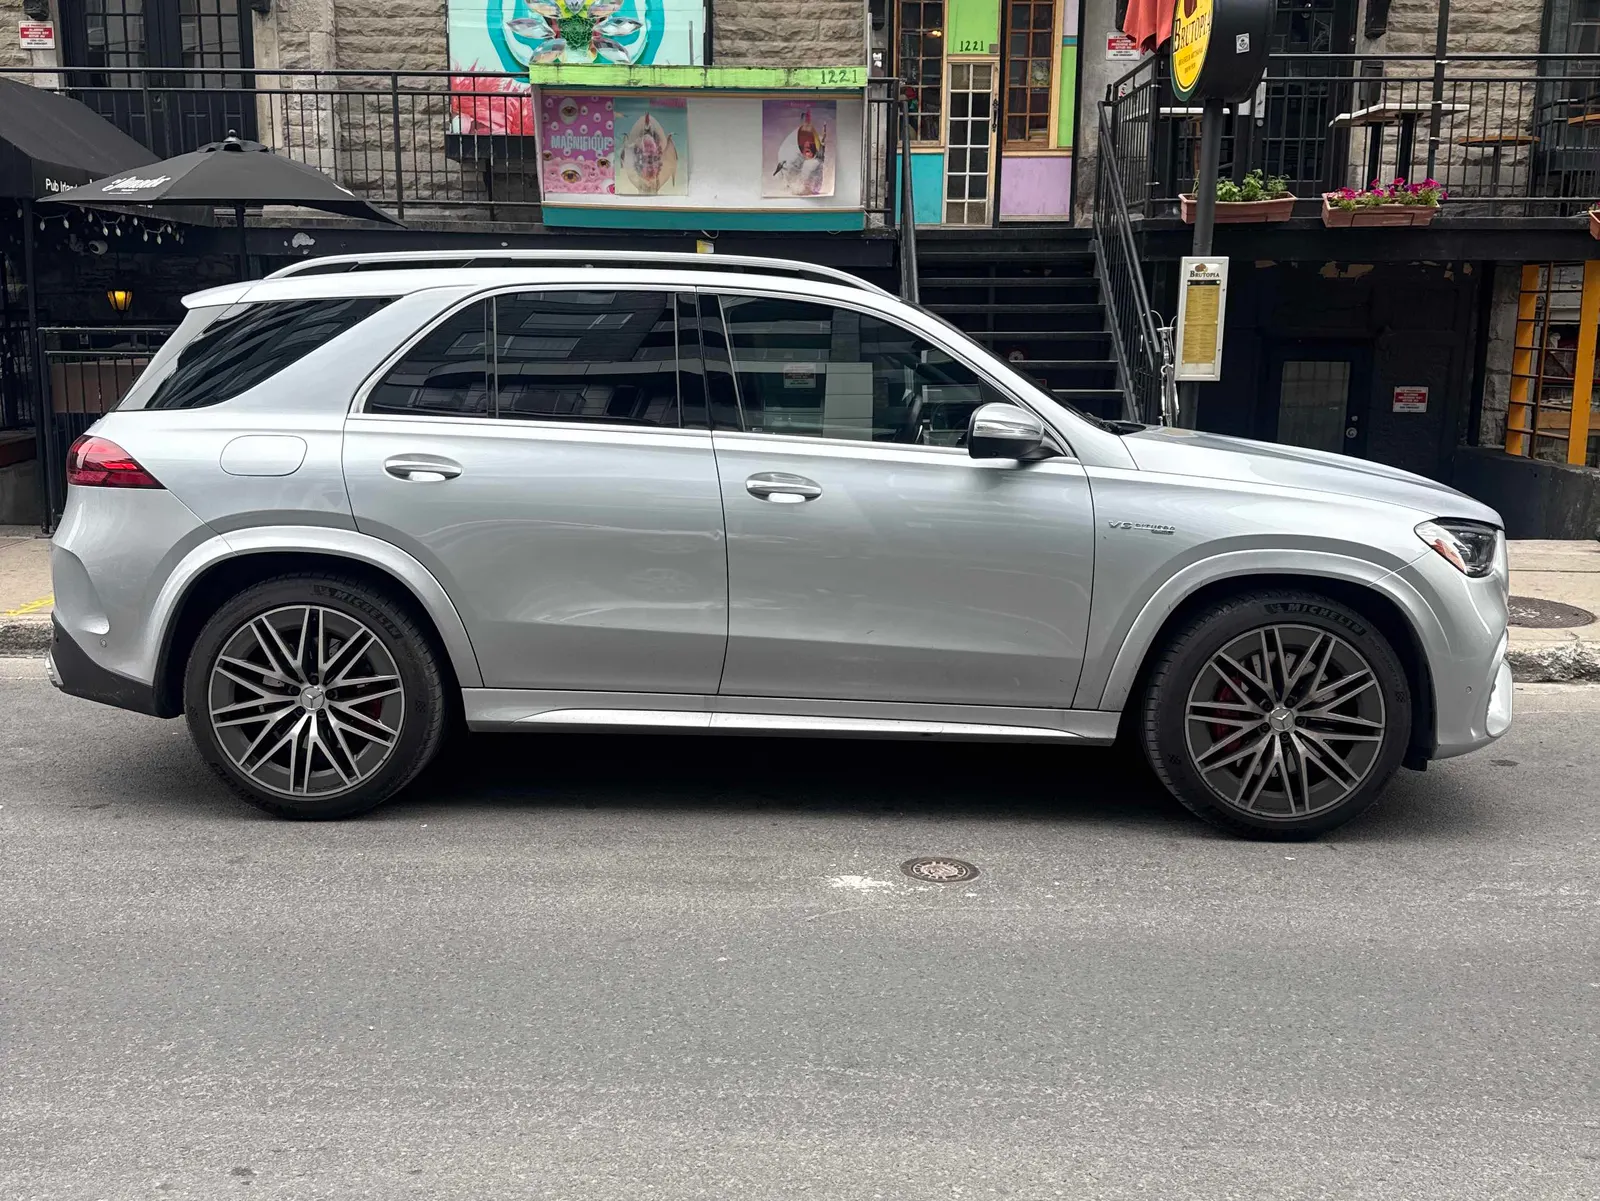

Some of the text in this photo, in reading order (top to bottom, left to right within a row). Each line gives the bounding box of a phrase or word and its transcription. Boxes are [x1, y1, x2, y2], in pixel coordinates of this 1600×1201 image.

[1174, 11, 1212, 52] BRUTOPIA
[959, 40, 985, 52] 1221
[820, 69, 858, 85] 1221
[551, 135, 612, 151] MAGNIFIQUE
[45, 178, 60, 192] Pub
[1189, 270, 1220, 278] BRUTOPIA
[1287, 602, 1364, 635] MICHELIN
